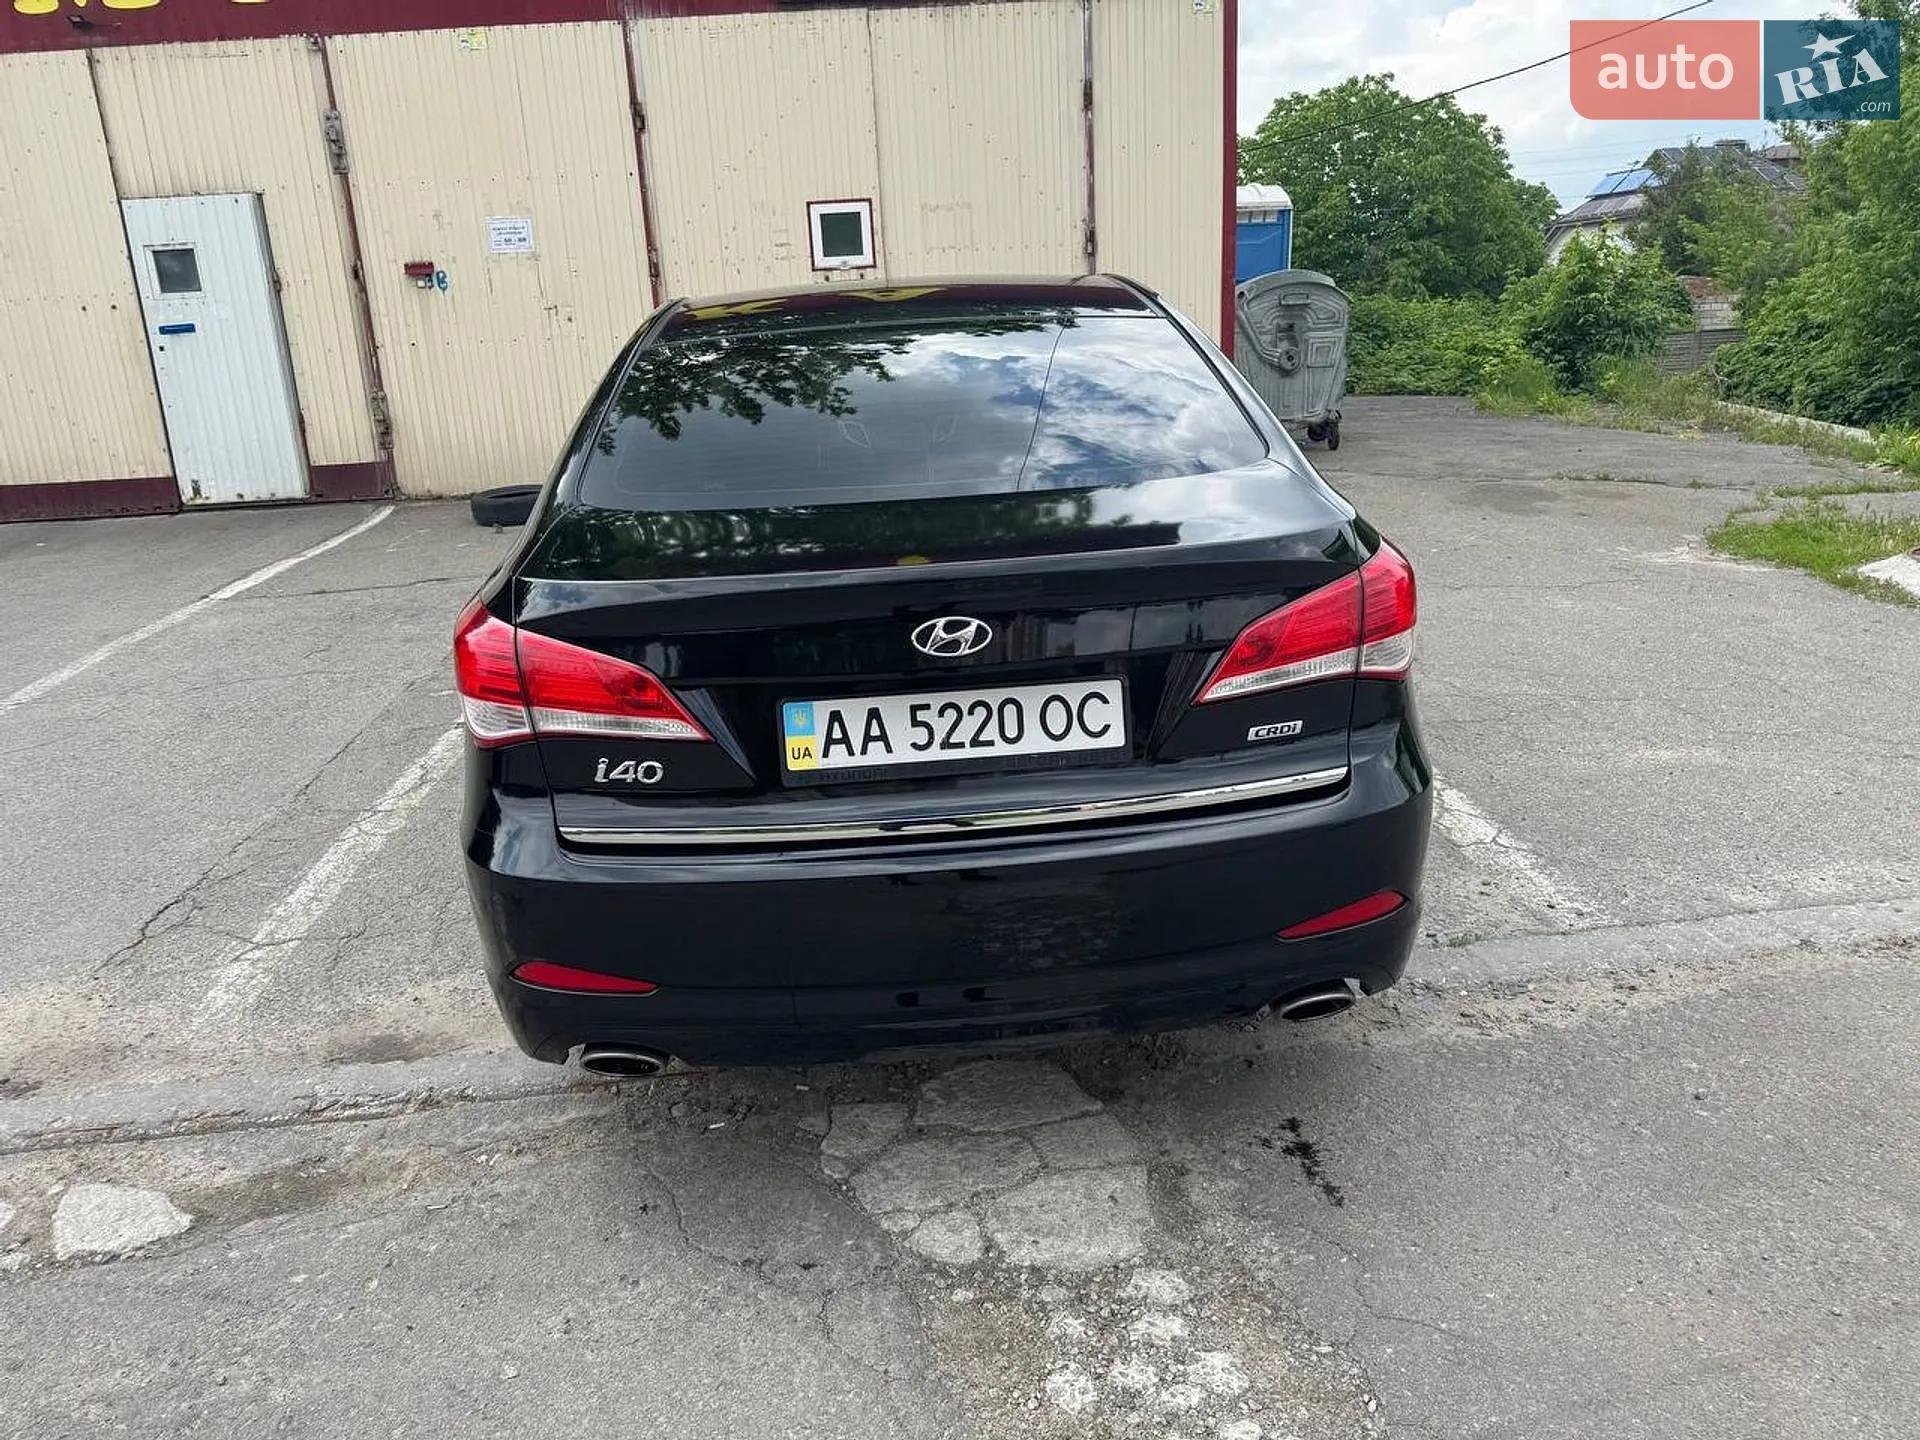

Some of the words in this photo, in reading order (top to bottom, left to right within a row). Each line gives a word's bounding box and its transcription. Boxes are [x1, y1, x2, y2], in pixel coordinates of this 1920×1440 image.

[822, 706, 893, 759] AA
[908, 697, 1025, 751] 5220
[1039, 691, 1111, 742] OC
[1255, 723, 1297, 738] CRDi
[791, 746, 813, 761] UA
[594, 757, 664, 783] i40
